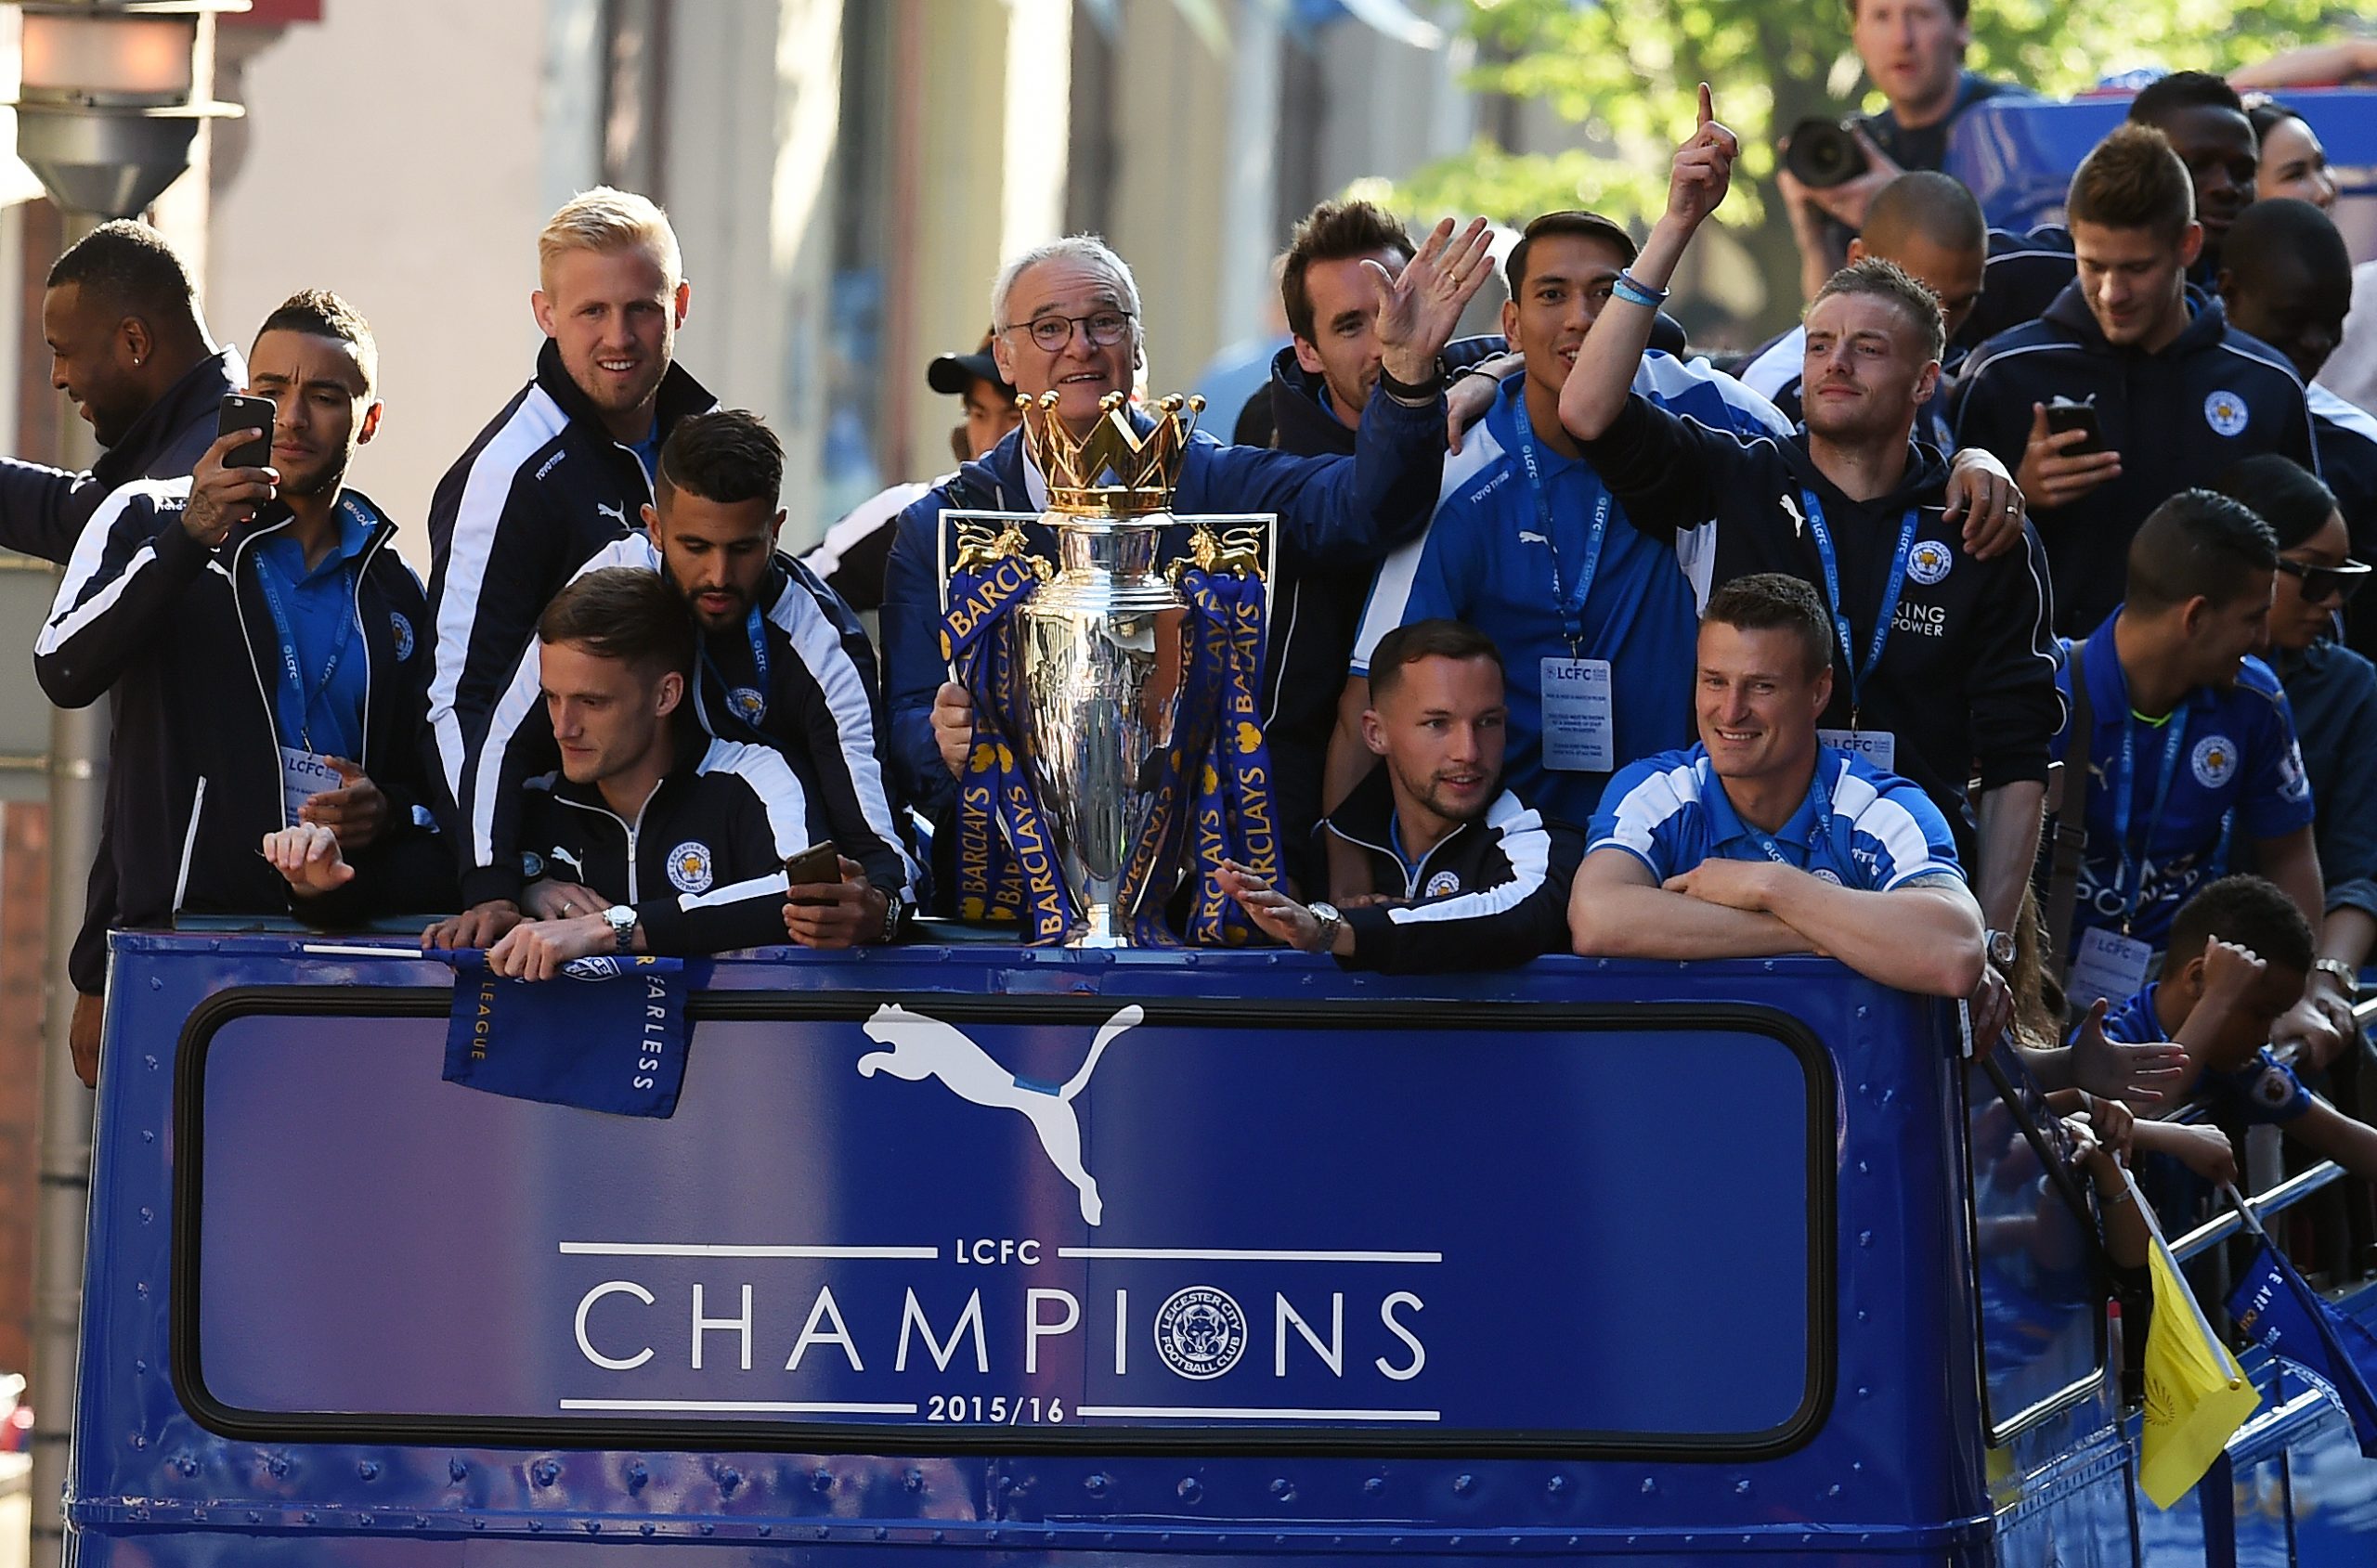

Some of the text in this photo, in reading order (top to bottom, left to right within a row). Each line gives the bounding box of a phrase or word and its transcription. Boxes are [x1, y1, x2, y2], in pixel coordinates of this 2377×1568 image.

[1523, 451, 1539, 479] LCFC
[1471, 483, 1492, 504] TOYO
[1592, 504, 1607, 531] LCFC
[1814, 525, 1828, 546] LCFC
[1899, 530, 1913, 554] LCFC
[947, 560, 1033, 638] BARCL
[1891, 617, 1943, 638] POWER
[1838, 629, 1850, 655] LCFC
[1871, 635, 1884, 661] LCFC
[284, 654, 298, 680] LCFC
[755, 650, 767, 673] LCFC
[1557, 667, 1591, 680] LCFC
[289, 758, 325, 777] LCFC
[1239, 767, 1278, 885] RCLAYS
[963, 786, 991, 893] BARCLAYS
[1008, 785, 1063, 936] BARCLAYS
[1767, 846, 1786, 864] LCF
[471, 982, 496, 1060] LEAGUE
[632, 975, 667, 1090] EARLESS
[956, 1239, 1041, 1265] LCFC
[1162, 1292, 1241, 1330] LEICESTER CITY
[1161, 1335, 1240, 1374] FOOTBALL CLUB
[927, 1396, 1064, 1426] 2015/16
